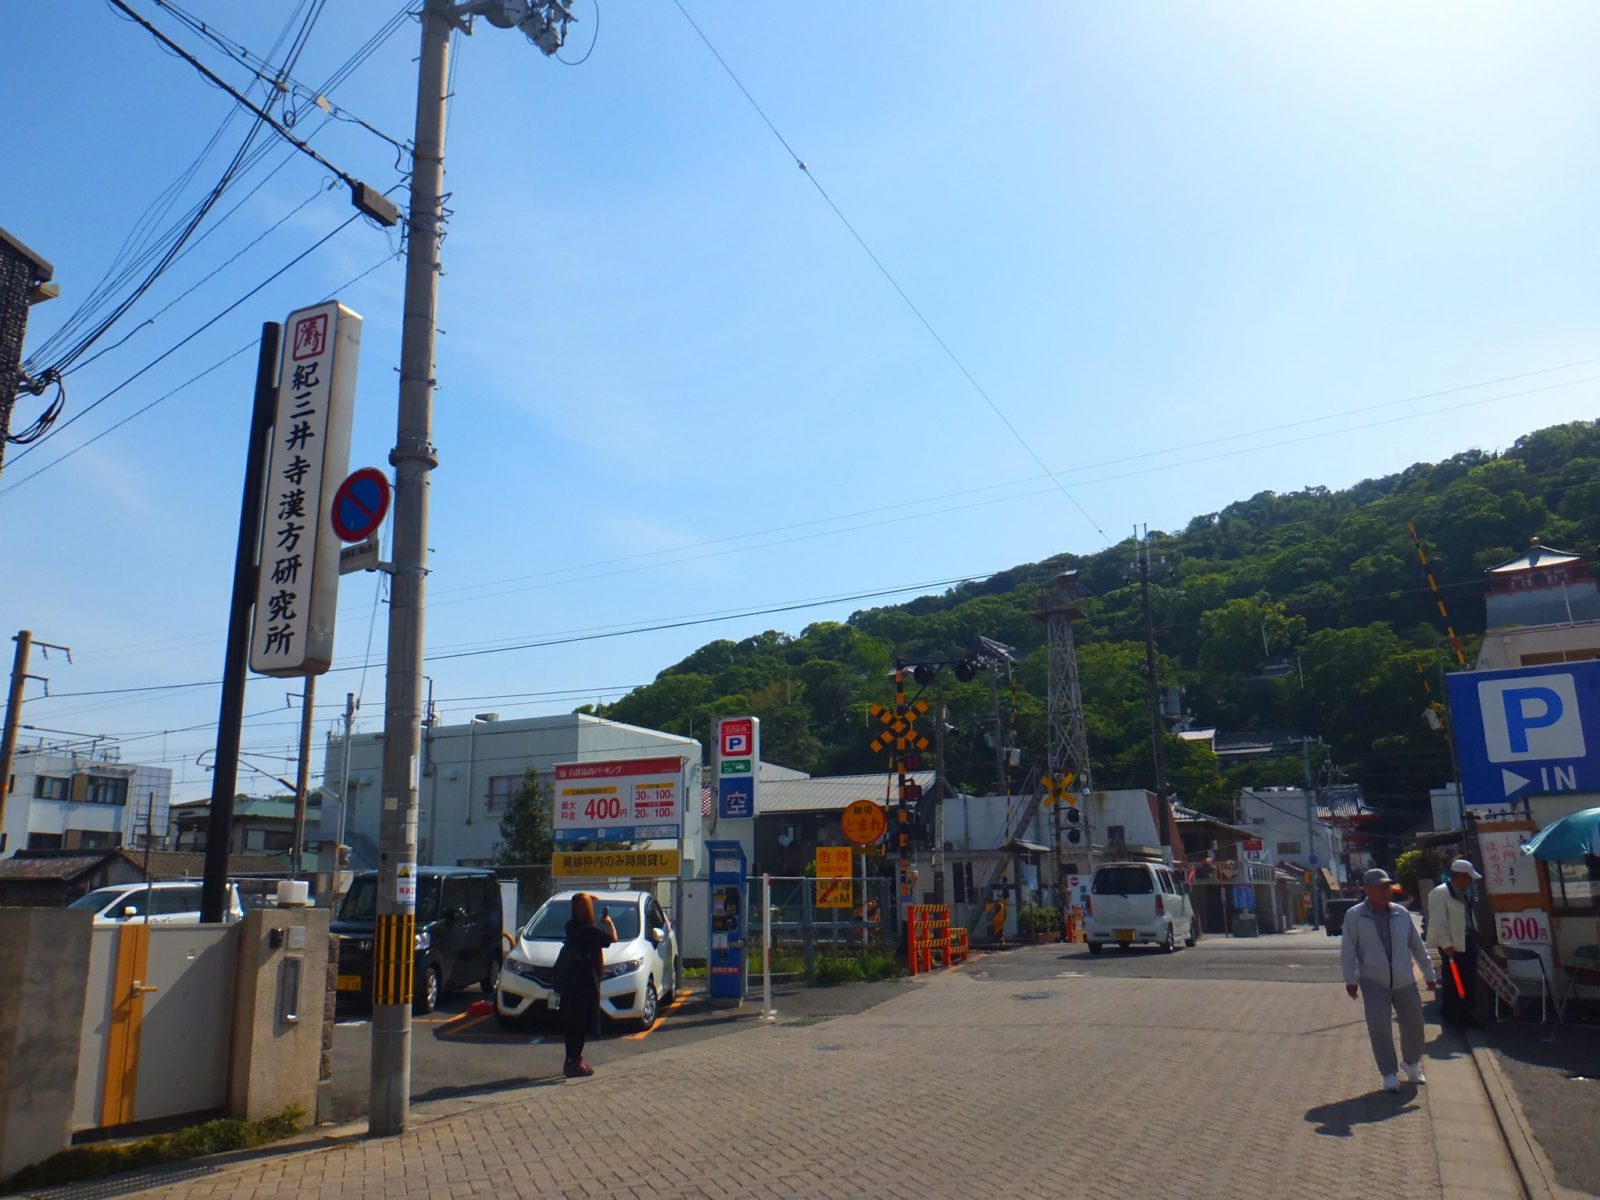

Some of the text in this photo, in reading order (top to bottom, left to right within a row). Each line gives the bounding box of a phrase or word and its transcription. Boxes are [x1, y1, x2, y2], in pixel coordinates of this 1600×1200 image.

[263, 361, 320, 655] 紀三井寺漢方研究所
[1502, 687, 1564, 753] P
[729, 738, 742, 750] P
[1541, 765, 1576, 791] IN
[727, 791, 747, 814] 空
[845, 817, 882, 832] とまれ
[819, 850, 849, 864] 危険
